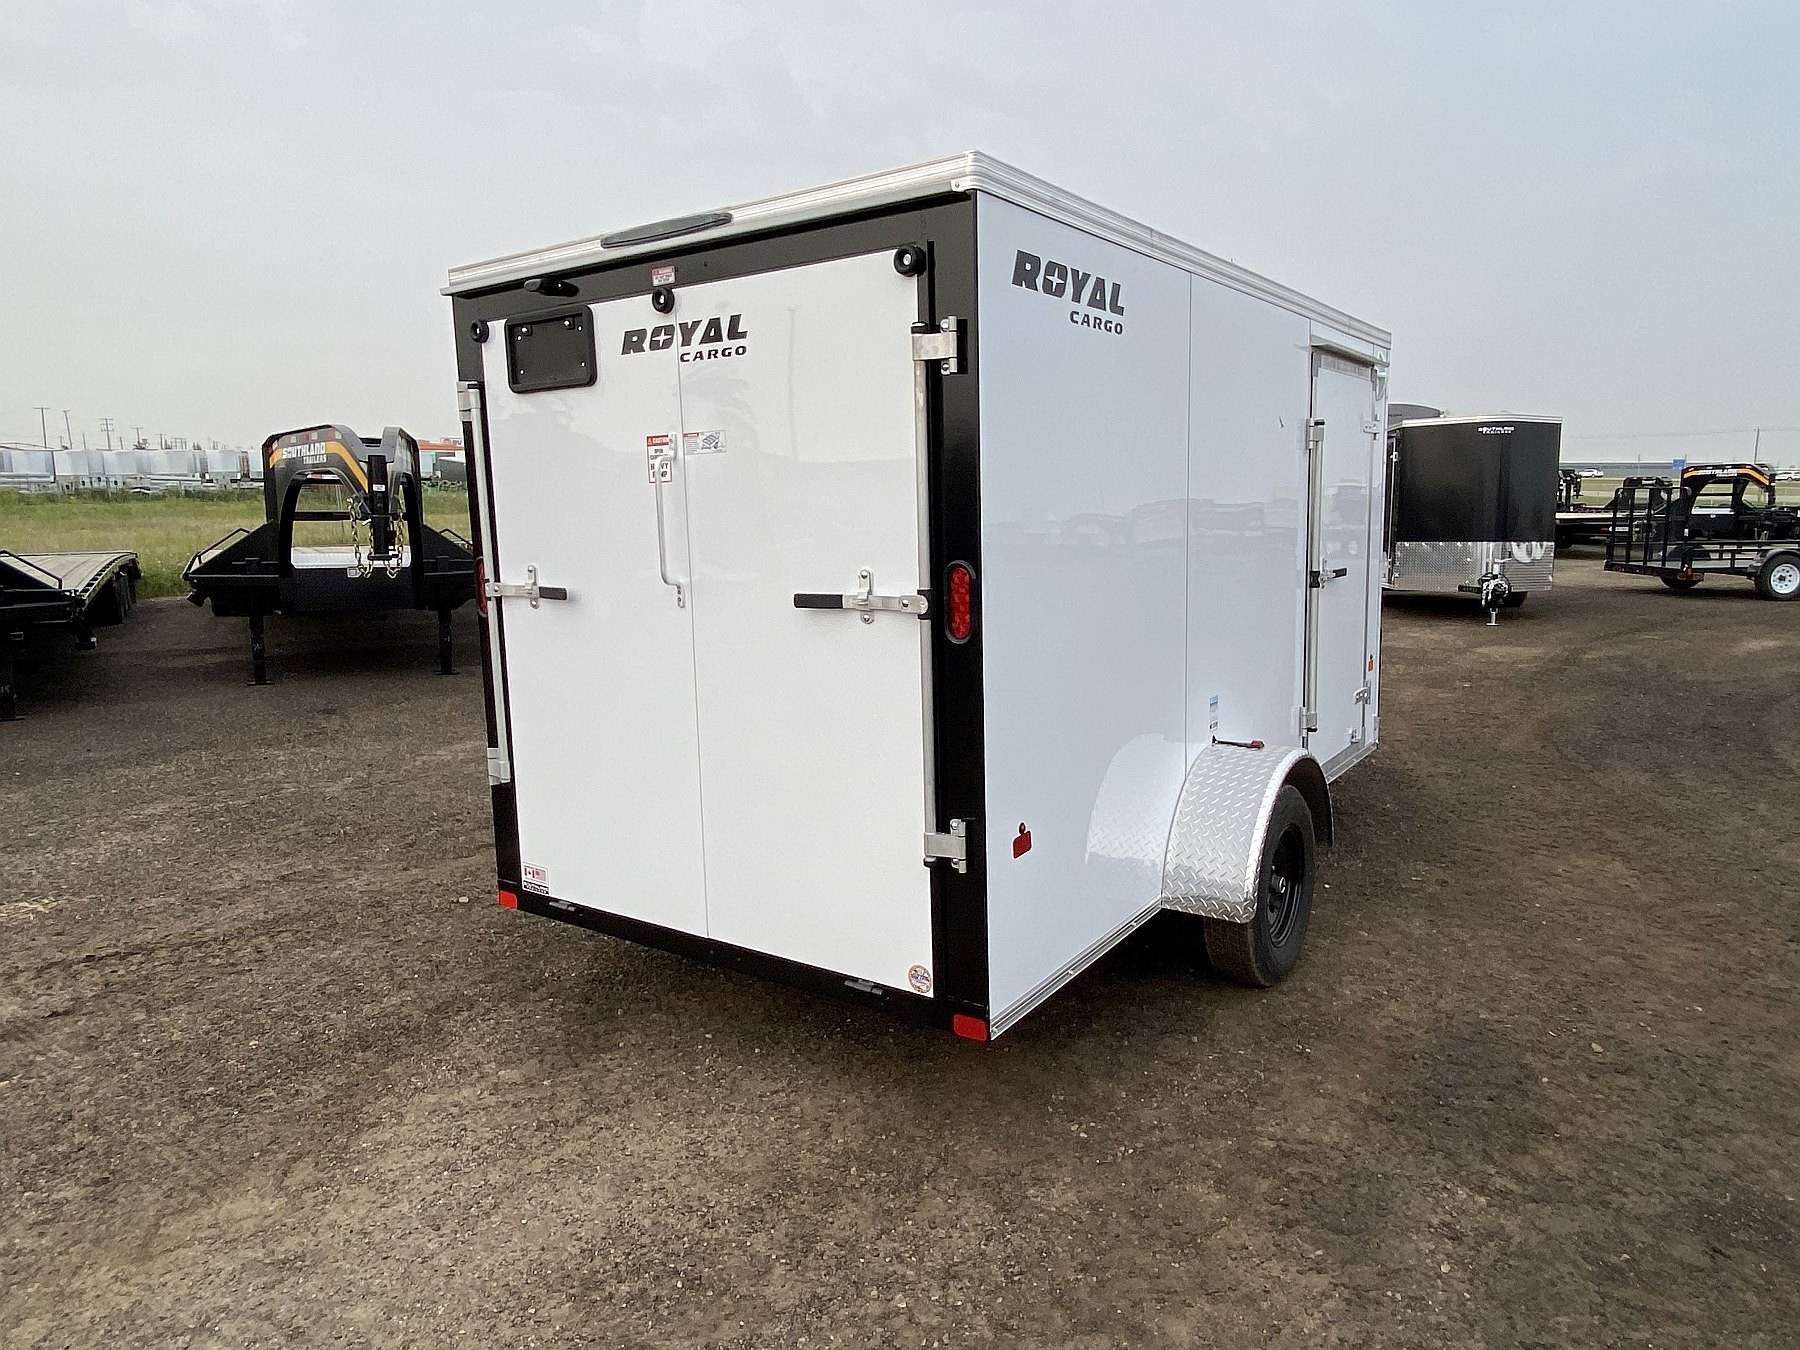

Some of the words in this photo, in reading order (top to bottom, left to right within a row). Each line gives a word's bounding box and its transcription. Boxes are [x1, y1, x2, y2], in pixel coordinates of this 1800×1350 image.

[1011, 249, 1125, 316] ROYAL
[621, 313, 749, 355] ROYAL
[1070, 310, 1123, 335] CARGO
[680, 345, 747, 362] CARGO
[282, 441, 326, 459] SOUTHLAND
